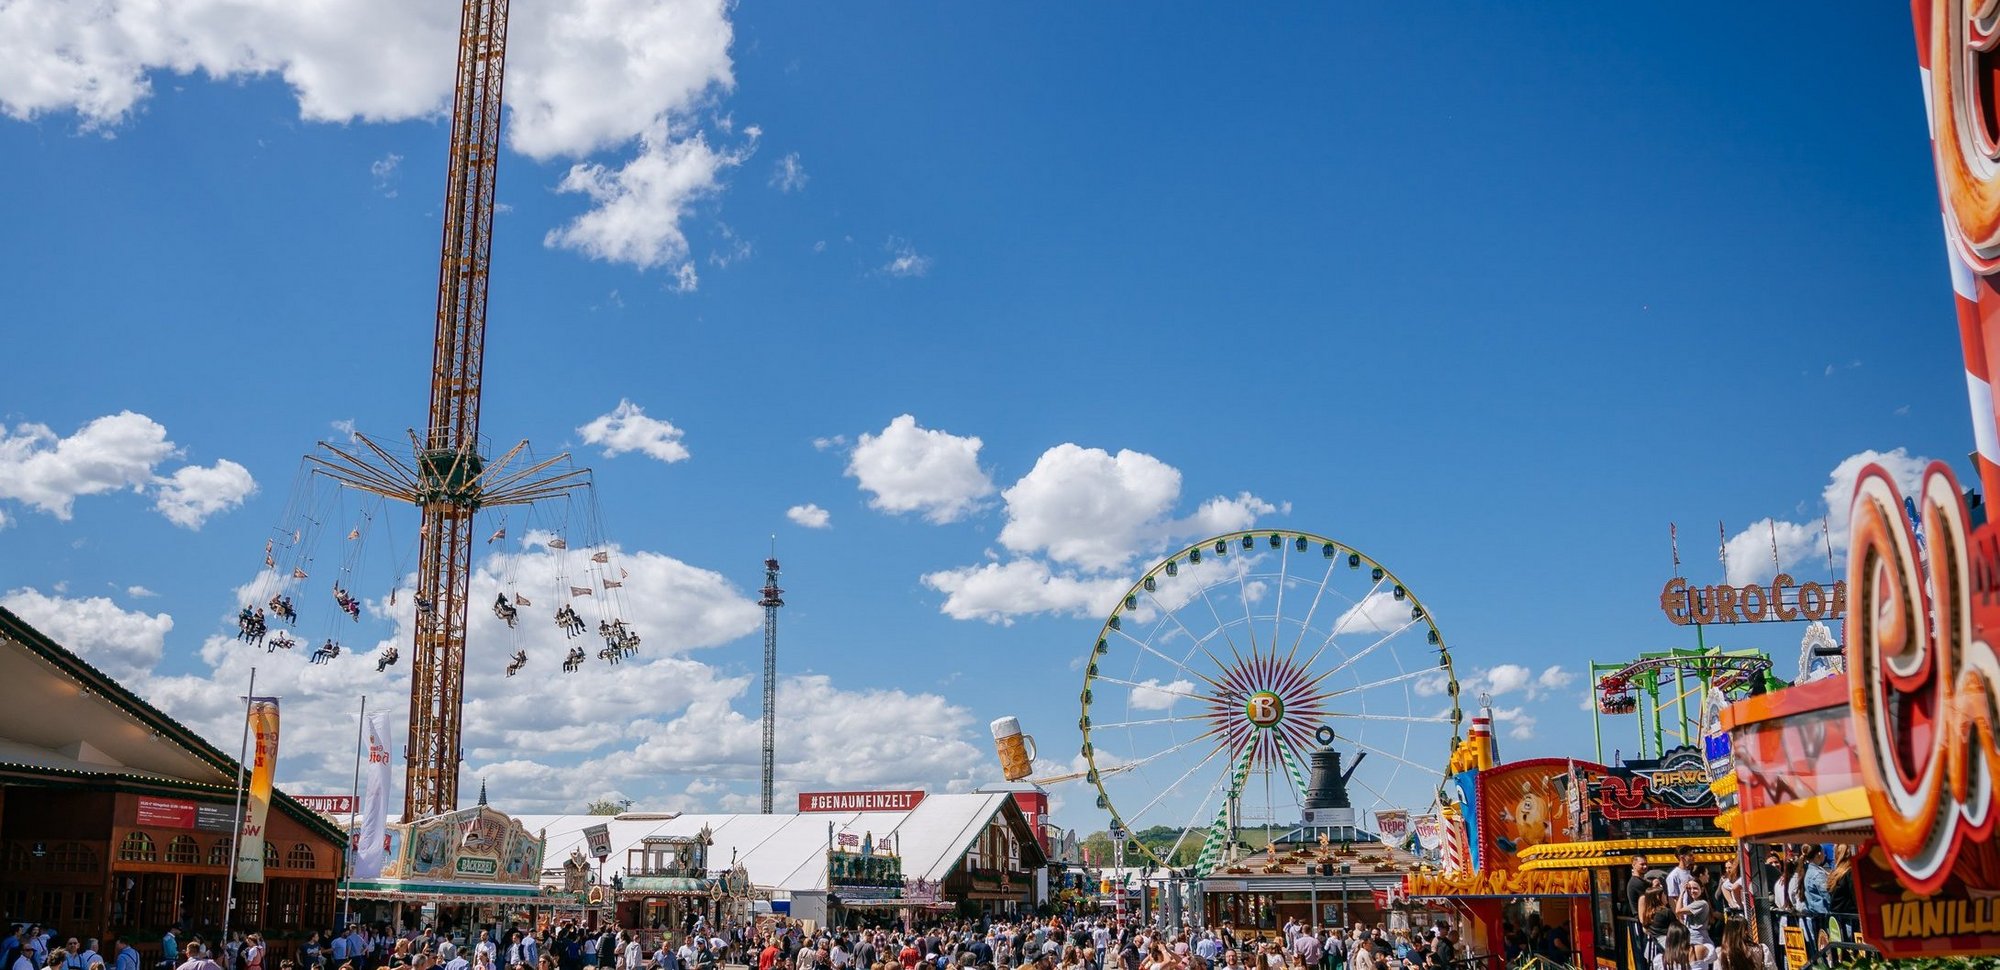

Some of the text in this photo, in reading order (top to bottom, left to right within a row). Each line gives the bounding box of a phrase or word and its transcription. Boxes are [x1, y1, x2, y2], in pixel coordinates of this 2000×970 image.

[1251, 697, 1277, 722] B
[295, 798, 338, 811] SENWIRT
[811, 794, 912, 809] #GENAUMEINZELT
[1113, 830, 1125, 838] WC
